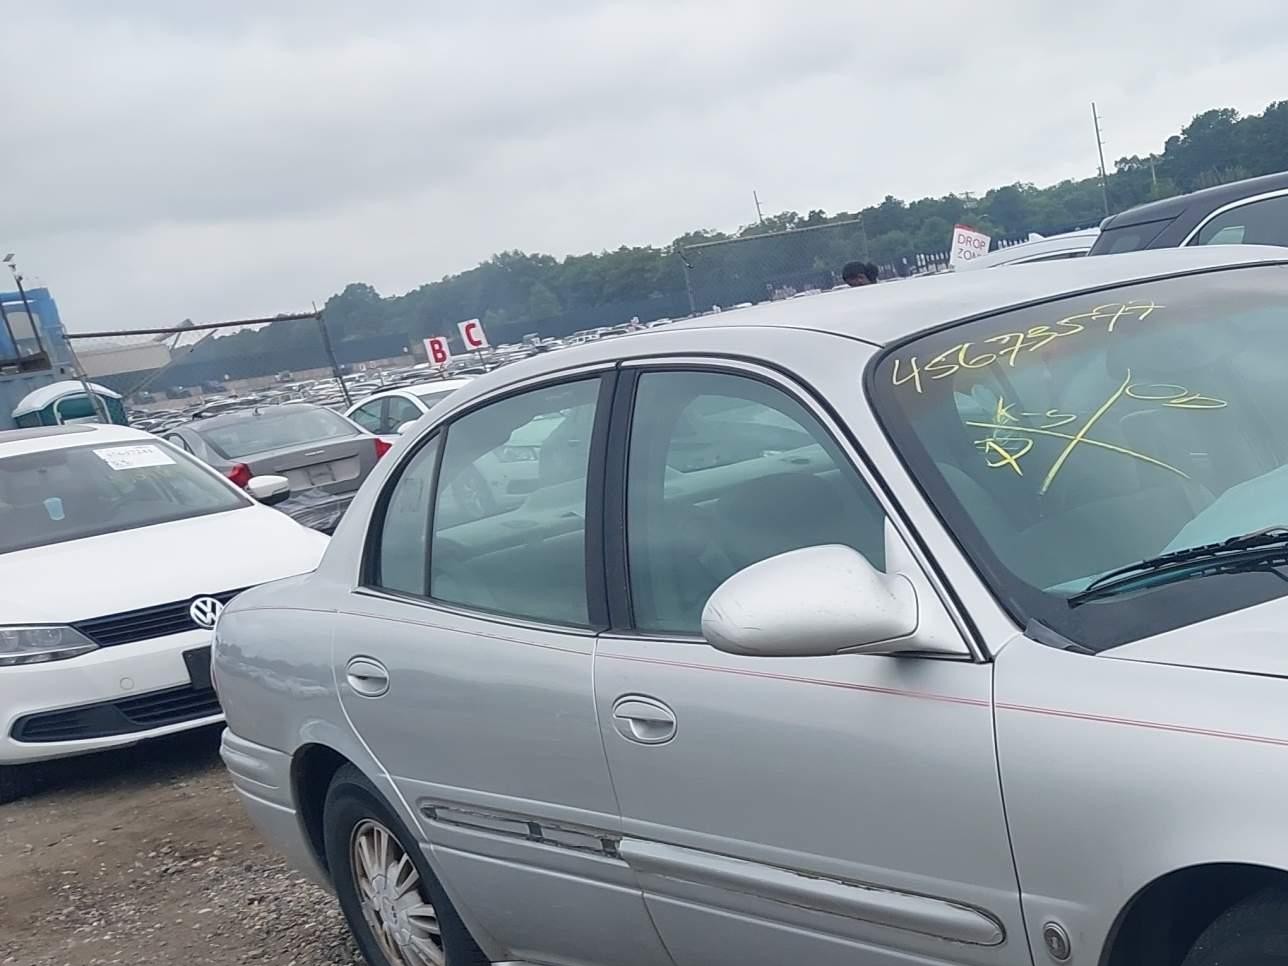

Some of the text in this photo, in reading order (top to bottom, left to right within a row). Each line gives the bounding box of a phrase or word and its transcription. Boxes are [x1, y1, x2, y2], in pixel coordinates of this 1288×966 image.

[957, 233, 986, 250] DROP
[465, 322, 483, 346] C
[430, 339, 447, 363] B
[190, 596, 222, 628] VW
